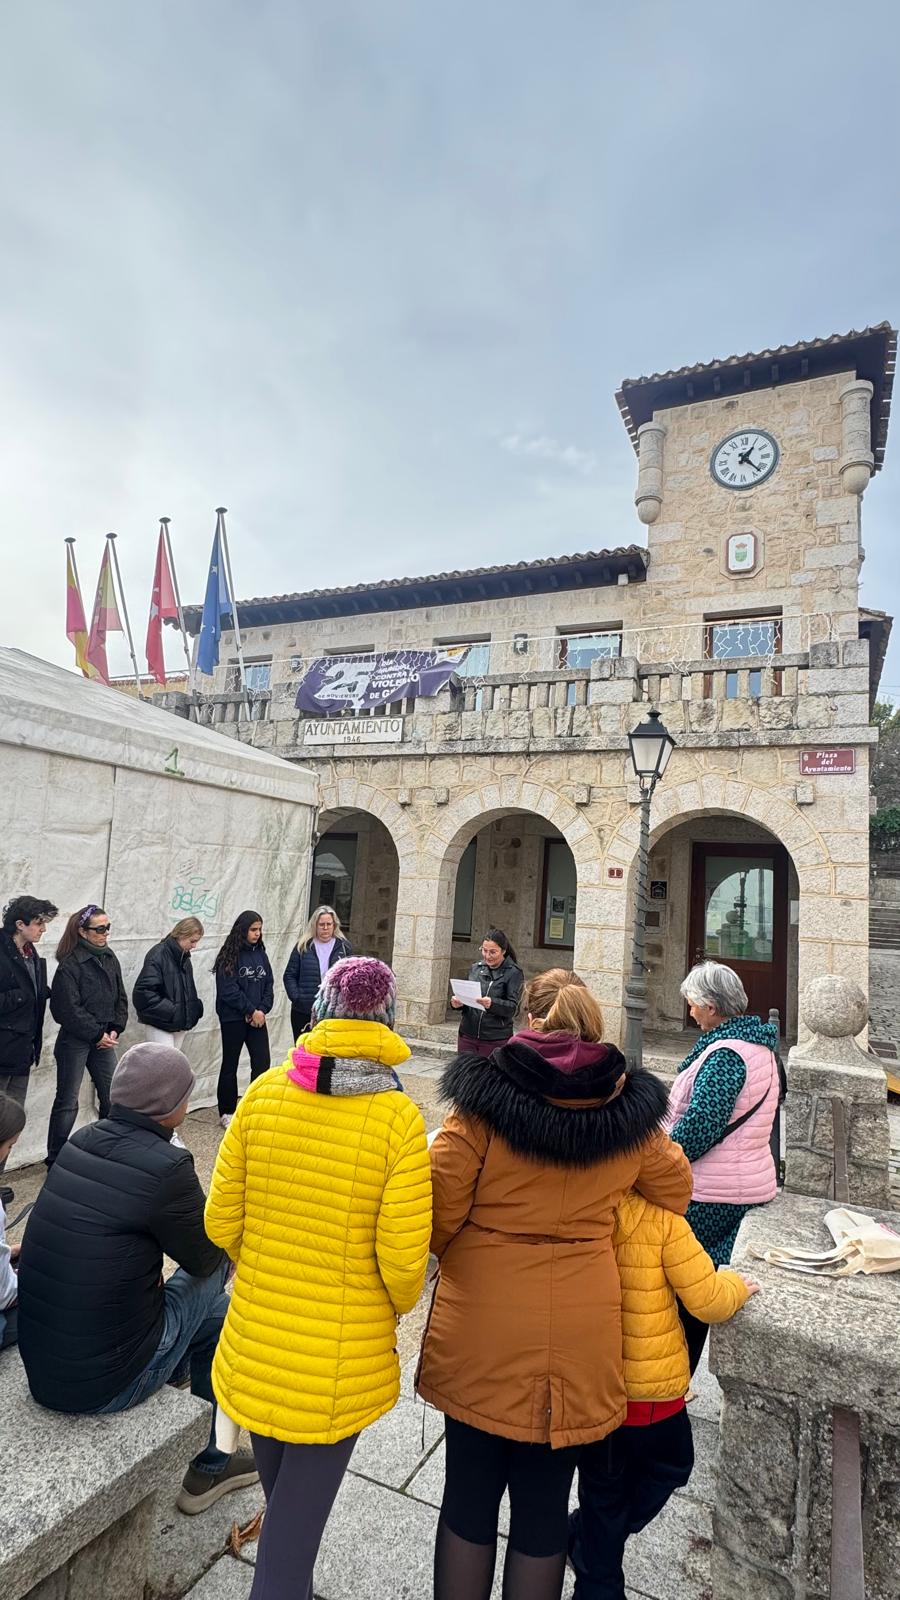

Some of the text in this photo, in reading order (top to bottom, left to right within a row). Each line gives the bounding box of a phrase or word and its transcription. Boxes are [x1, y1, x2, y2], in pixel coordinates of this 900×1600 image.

[314, 662, 377, 700] 25
[376, 671, 407, 680] CONTRA
[305, 719, 400, 736] AYUNTAMIENTO
[164, 746, 185, 777] 1
